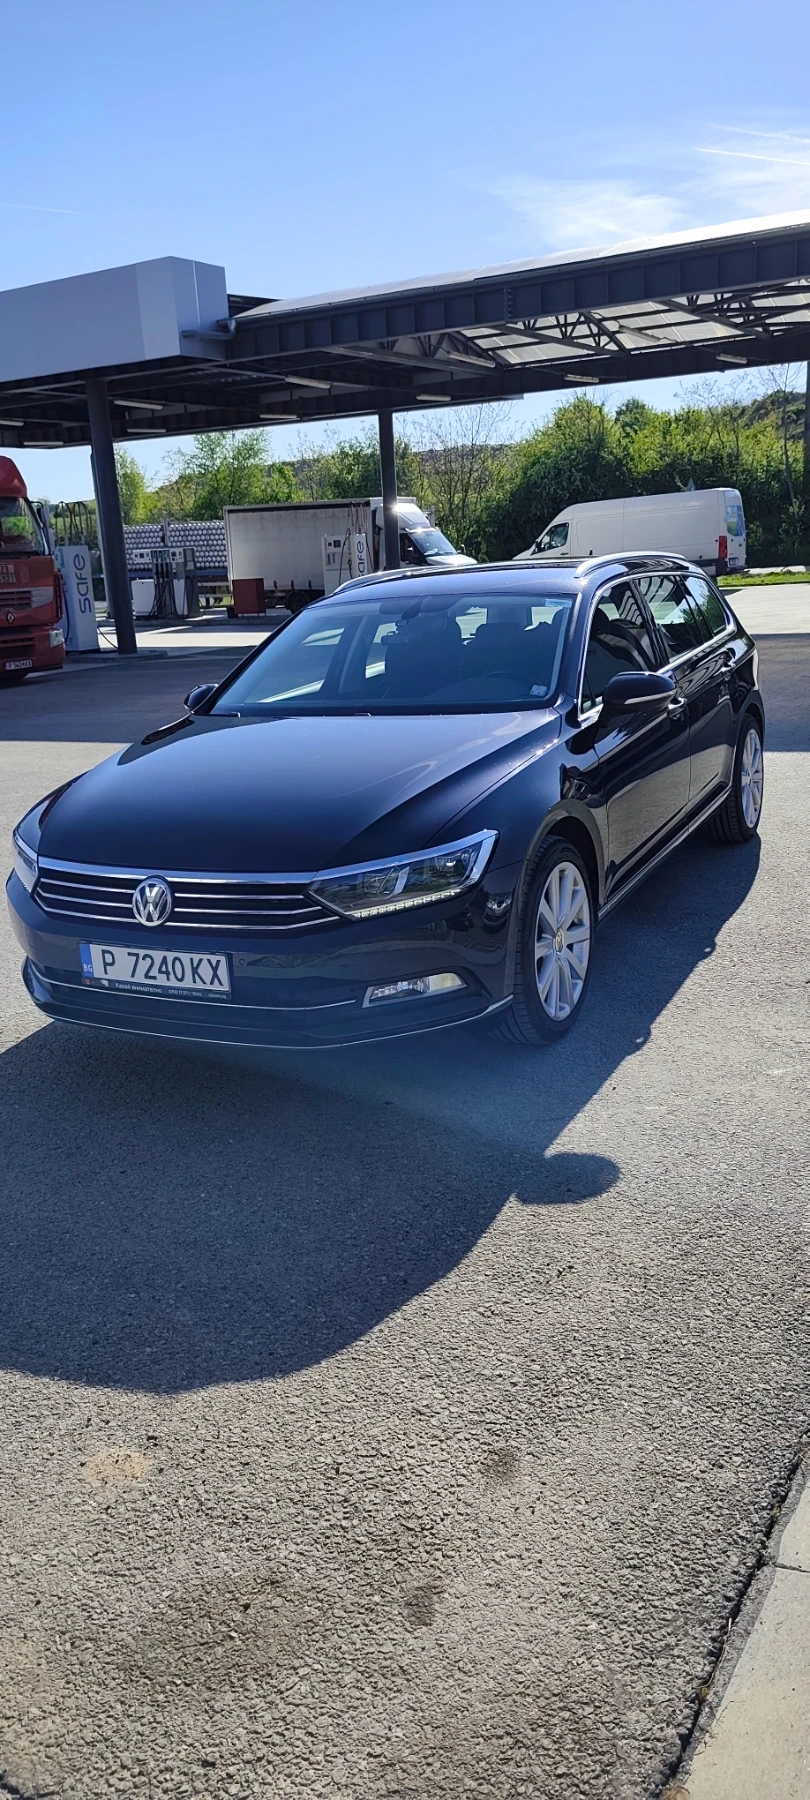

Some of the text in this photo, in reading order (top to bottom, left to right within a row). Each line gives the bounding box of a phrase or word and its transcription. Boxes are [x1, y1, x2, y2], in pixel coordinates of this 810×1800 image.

[357, 540, 365, 577] afe
[73, 553, 91, 613] safe
[83, 964, 93, 972] BG
[101, 949, 116, 976] P
